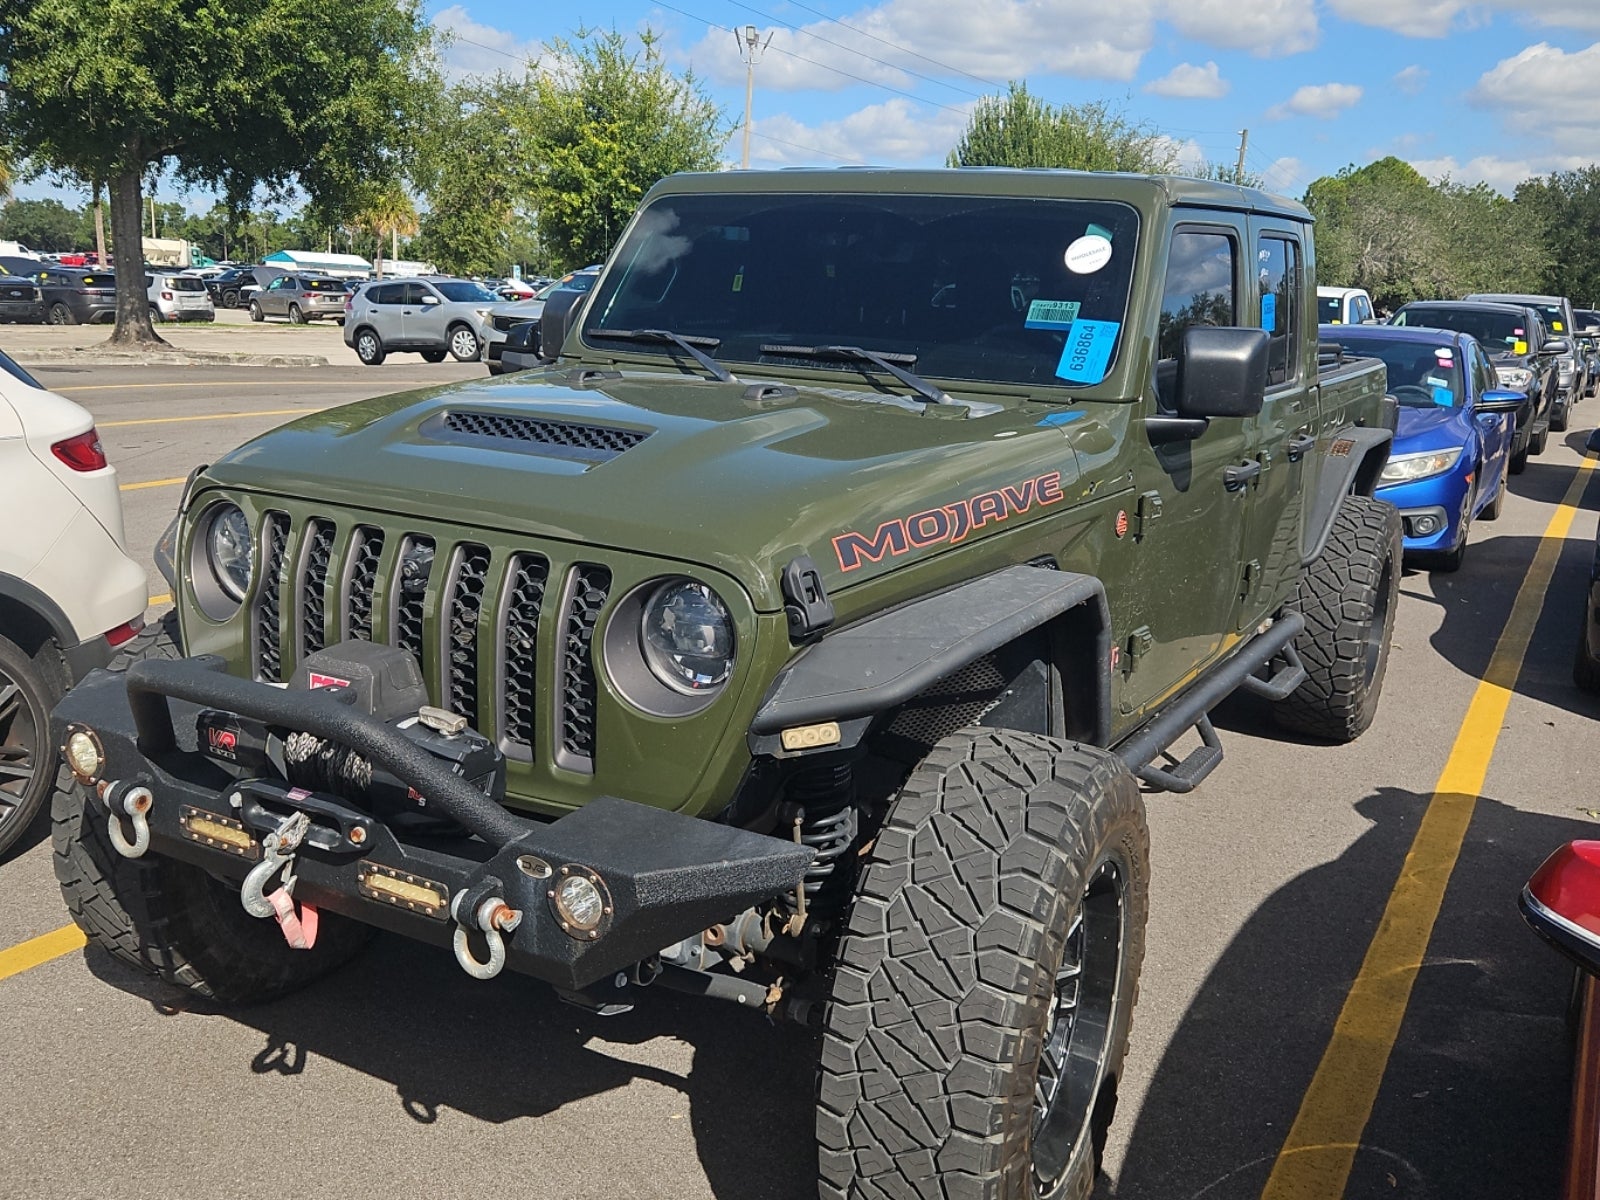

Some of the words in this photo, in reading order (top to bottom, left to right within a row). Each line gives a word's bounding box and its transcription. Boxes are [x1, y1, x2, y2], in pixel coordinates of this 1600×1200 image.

[1053, 302, 1075, 310] 9313
[1069, 325, 1096, 371] 636864
[831, 471, 1064, 572] MOJAVE
[208, 727, 236, 752] VR
